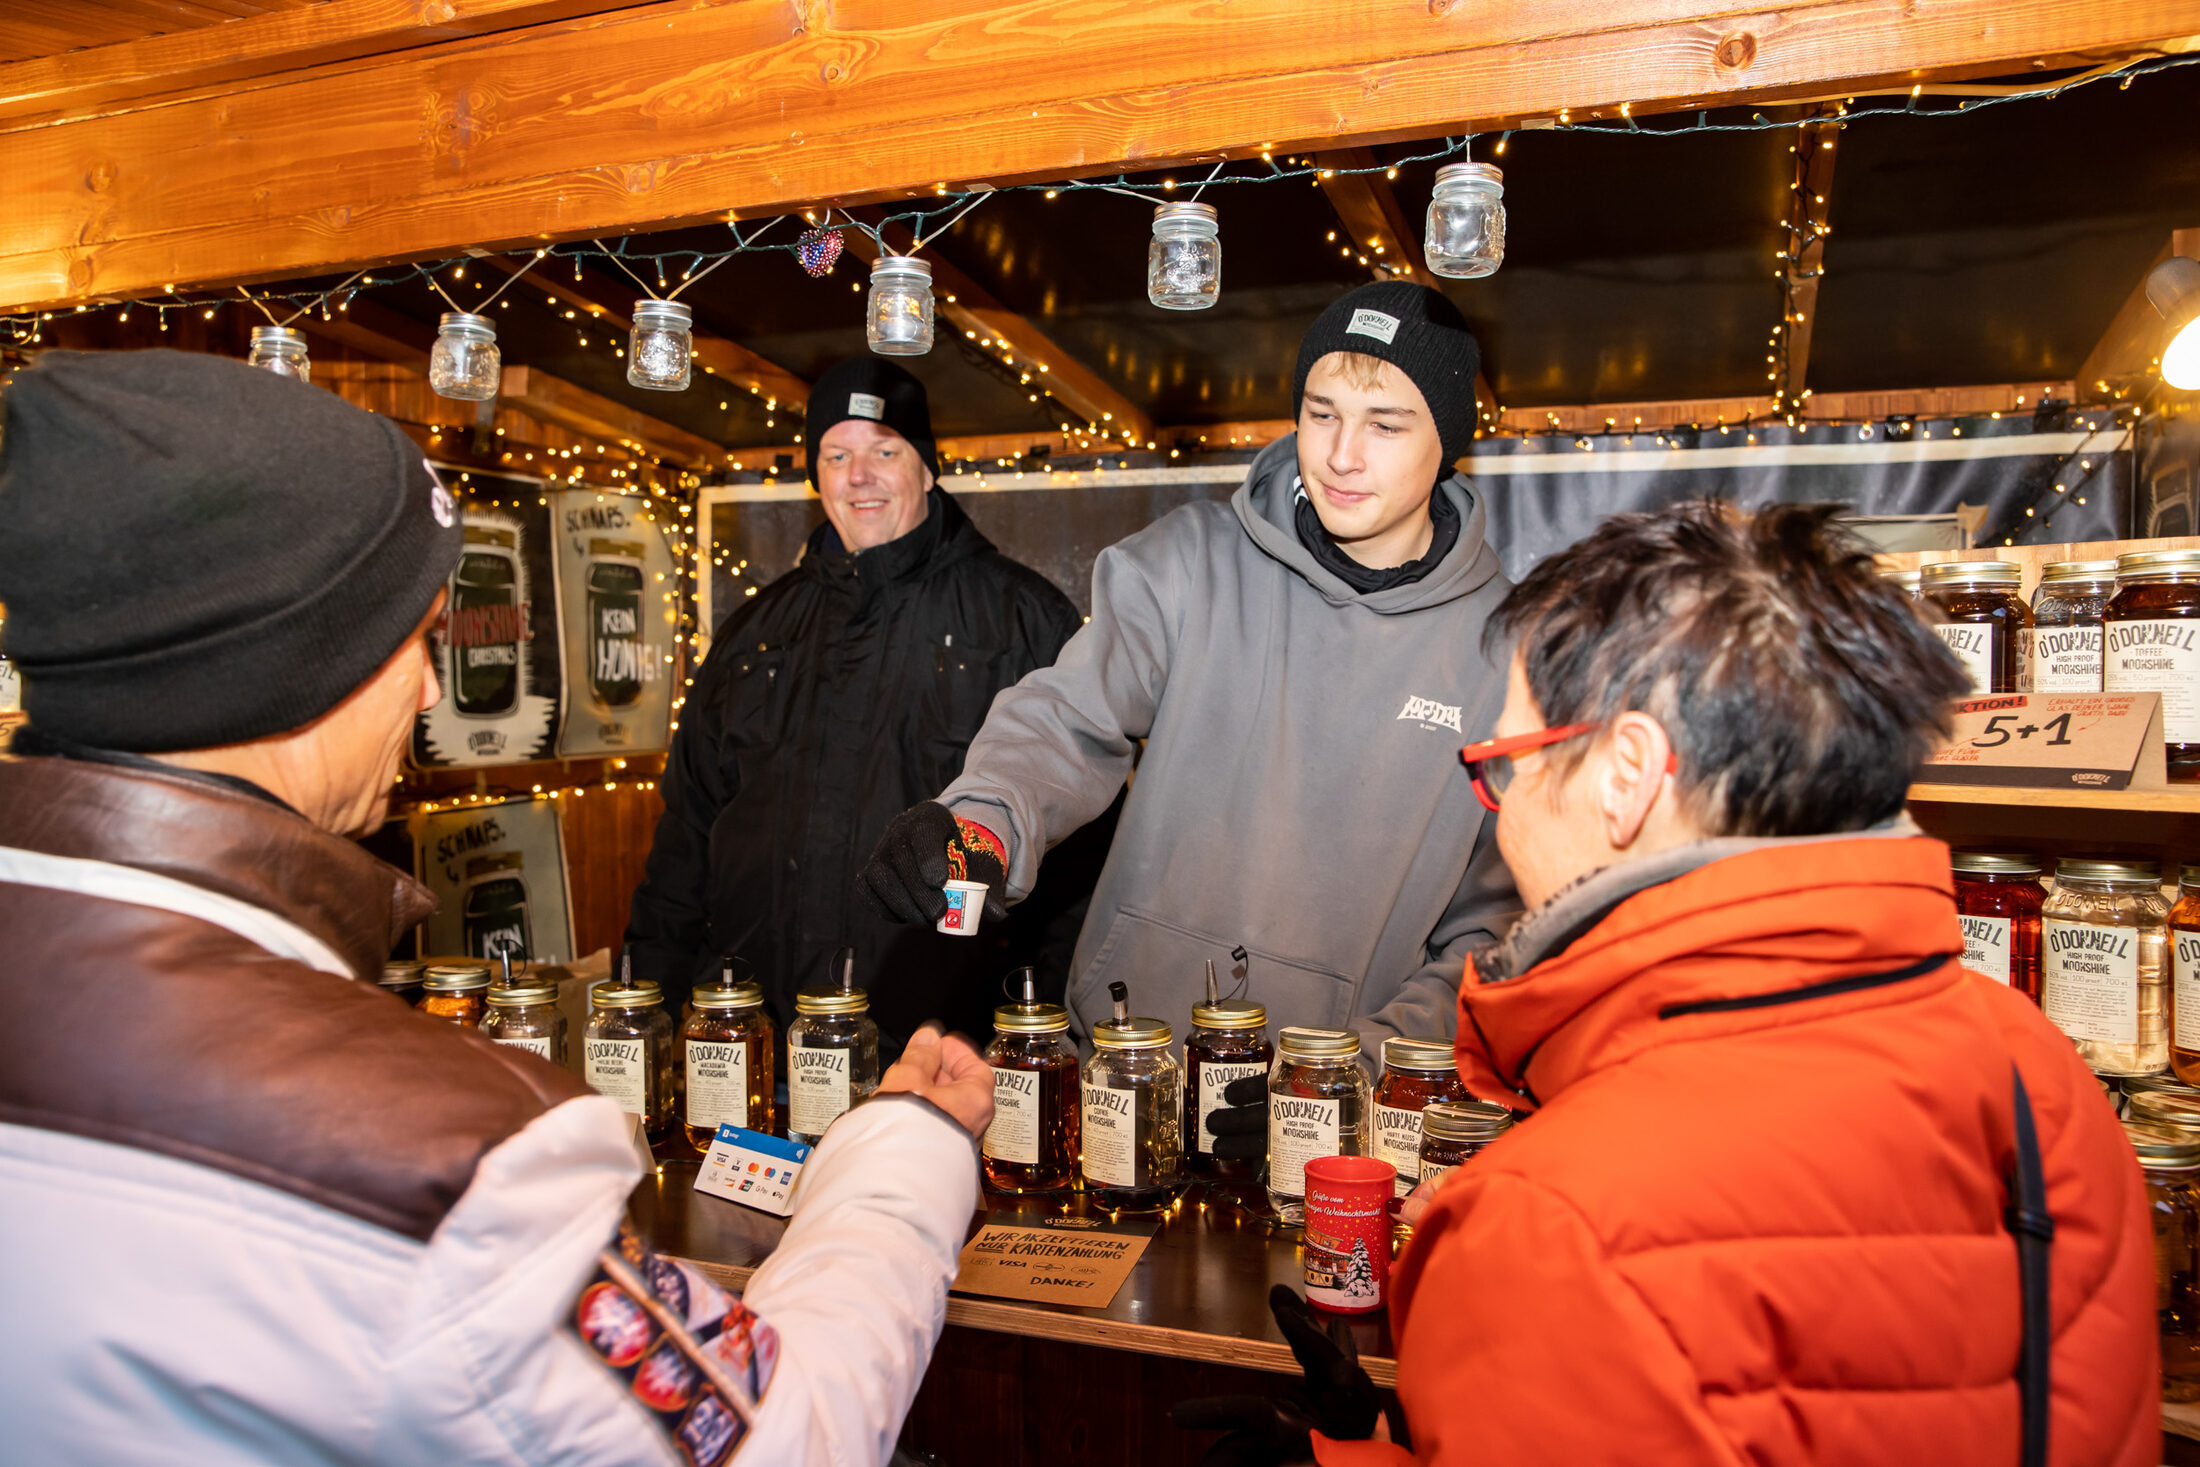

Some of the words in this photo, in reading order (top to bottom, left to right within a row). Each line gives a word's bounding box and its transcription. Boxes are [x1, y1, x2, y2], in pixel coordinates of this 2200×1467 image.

[602, 607, 636, 635] KEIN
[2039, 631, 2102, 658] O'DONNE
[2109, 624, 2196, 652] O'DONNELL
[2135, 648, 2163, 657] TOFFEE
[2051, 664, 2102, 674] MOONSHINE
[2122, 658, 2175, 670] MOONSHINE
[1972, 713, 2072, 747] 5+1
[2050, 928, 2129, 959] O'DONNELL
[2085, 953, 2105, 961] PROOF
[2062, 960, 2111, 975] MOONSHINE
[2105, 978, 2120, 986] 700
[587, 1042, 639, 1063] O'DONNELL
[689, 1045, 742, 1066] O'DONNELL
[792, 1051, 844, 1072] O'DONNELL
[995, 1071, 1033, 1096] ONNELL
[994, 1096, 1020, 1108] OONSHINE
[1088, 1114, 1116, 1128] MOONSHINE
[1273, 1099, 1333, 1126] O'DONNELL
[1376, 1109, 1423, 1134] O'DONNEL
[1282, 1127, 1320, 1140] MOONSHINE
[1402, 1133, 1415, 1141] NUSS
[1384, 1137, 1419, 1153] MOONSHINE
[983, 1232, 1019, 1242] WIR
[1018, 1233, 1131, 1250] AKZEPTIEREN
[976, 1242, 1009, 1250] NUR
[1009, 1242, 1125, 1260] KARTENZAHLUNG
[999, 1260, 1028, 1268] VISA
[1030, 1276, 1096, 1289] DANKE!
